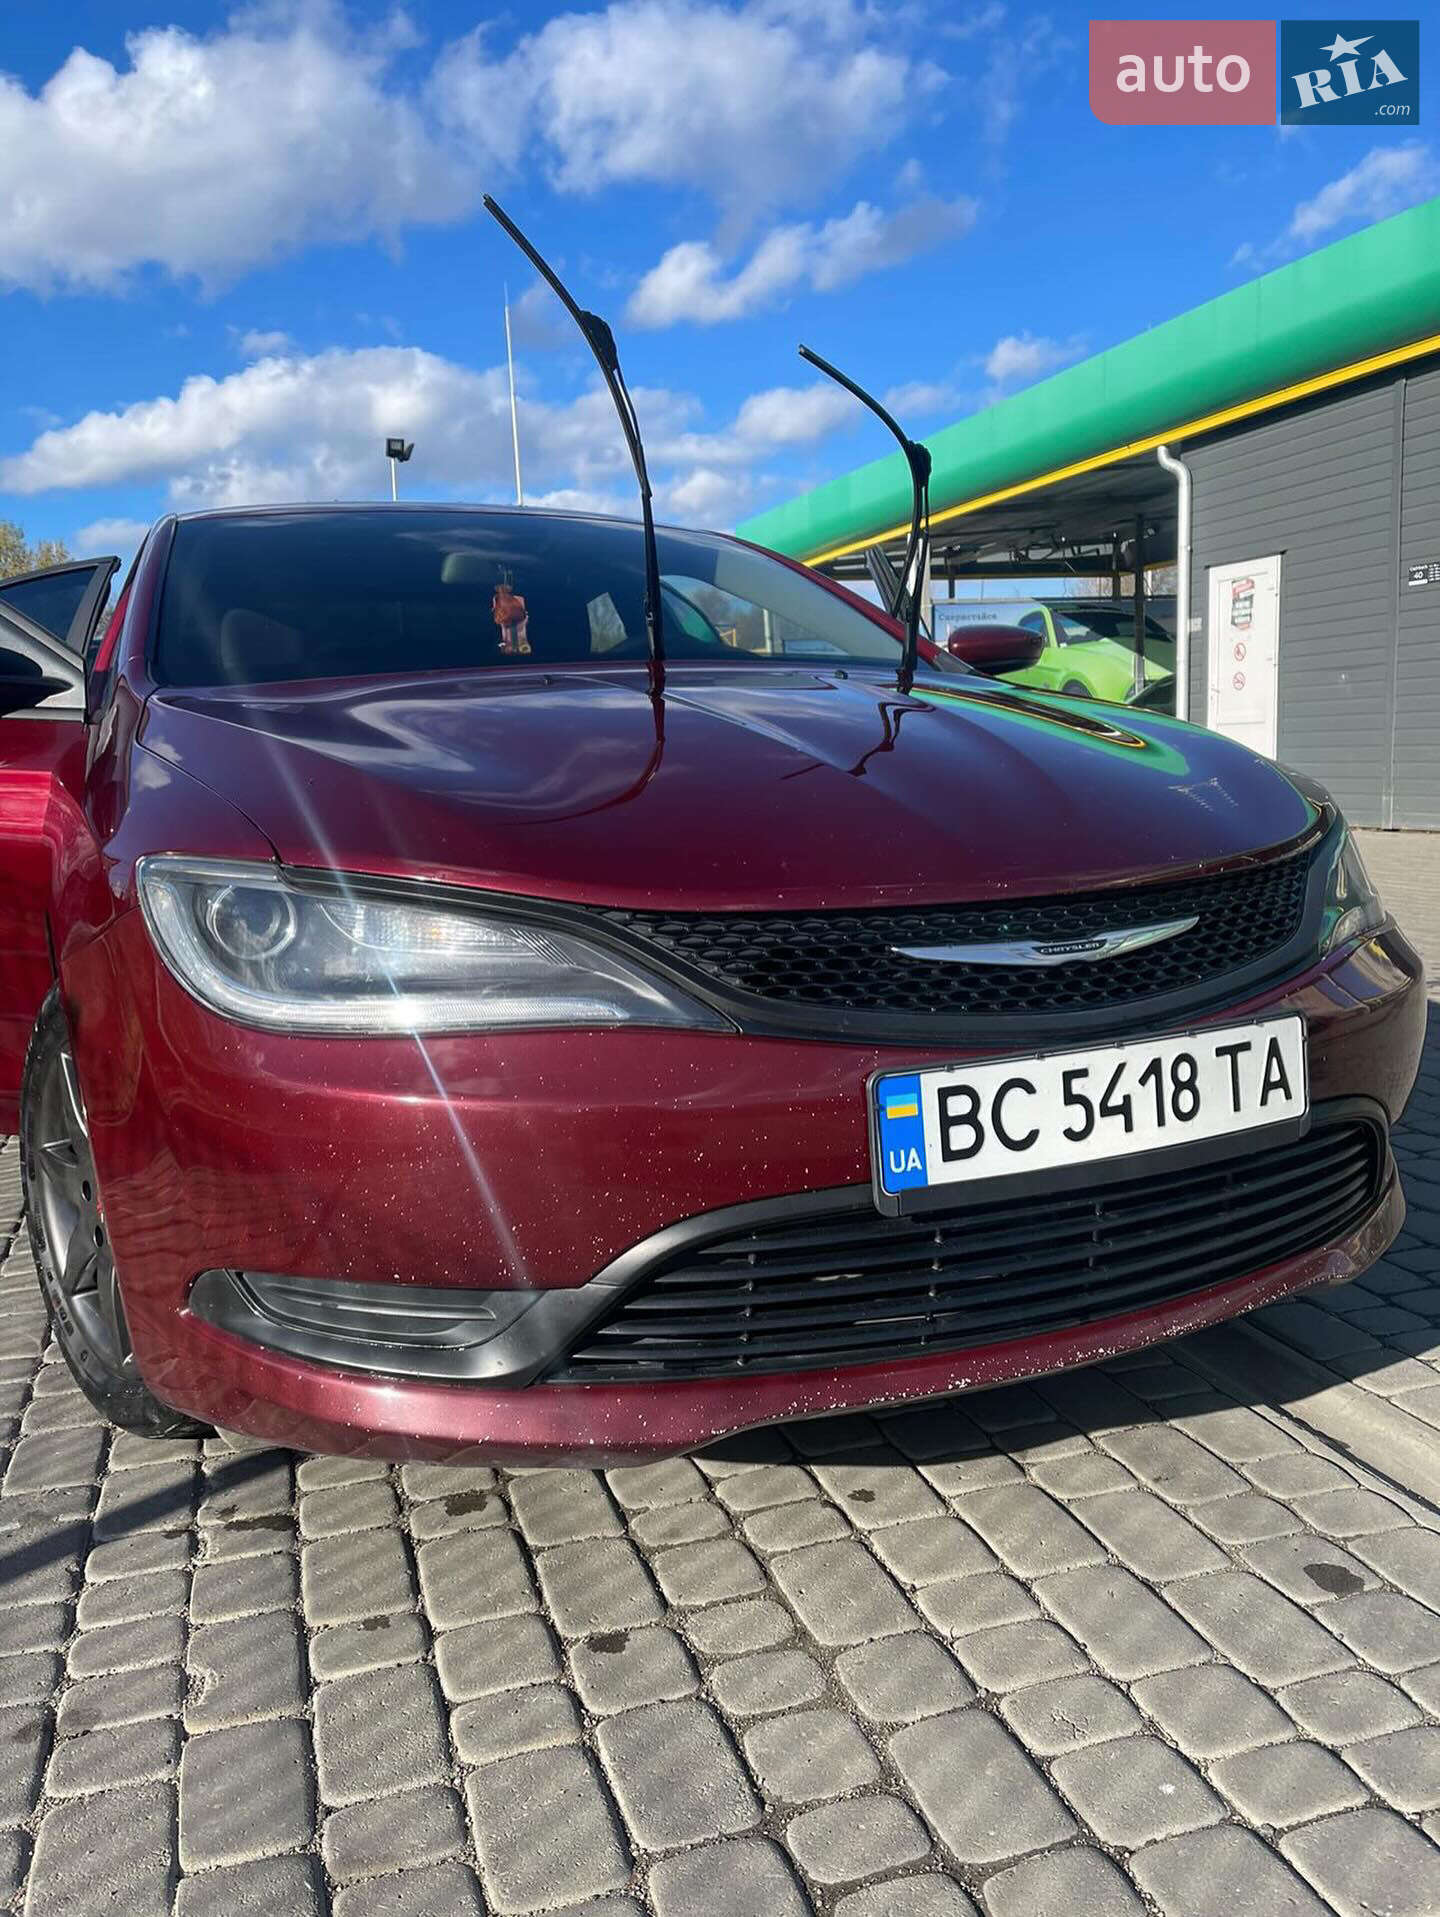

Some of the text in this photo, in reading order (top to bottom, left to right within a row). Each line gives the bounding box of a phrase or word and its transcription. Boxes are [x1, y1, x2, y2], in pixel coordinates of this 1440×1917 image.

[1040, 942, 1101, 954] CHRYSLER
[937, 1036, 1293, 1163] BC 5418 TA
[889, 1147, 923, 1174] UA
